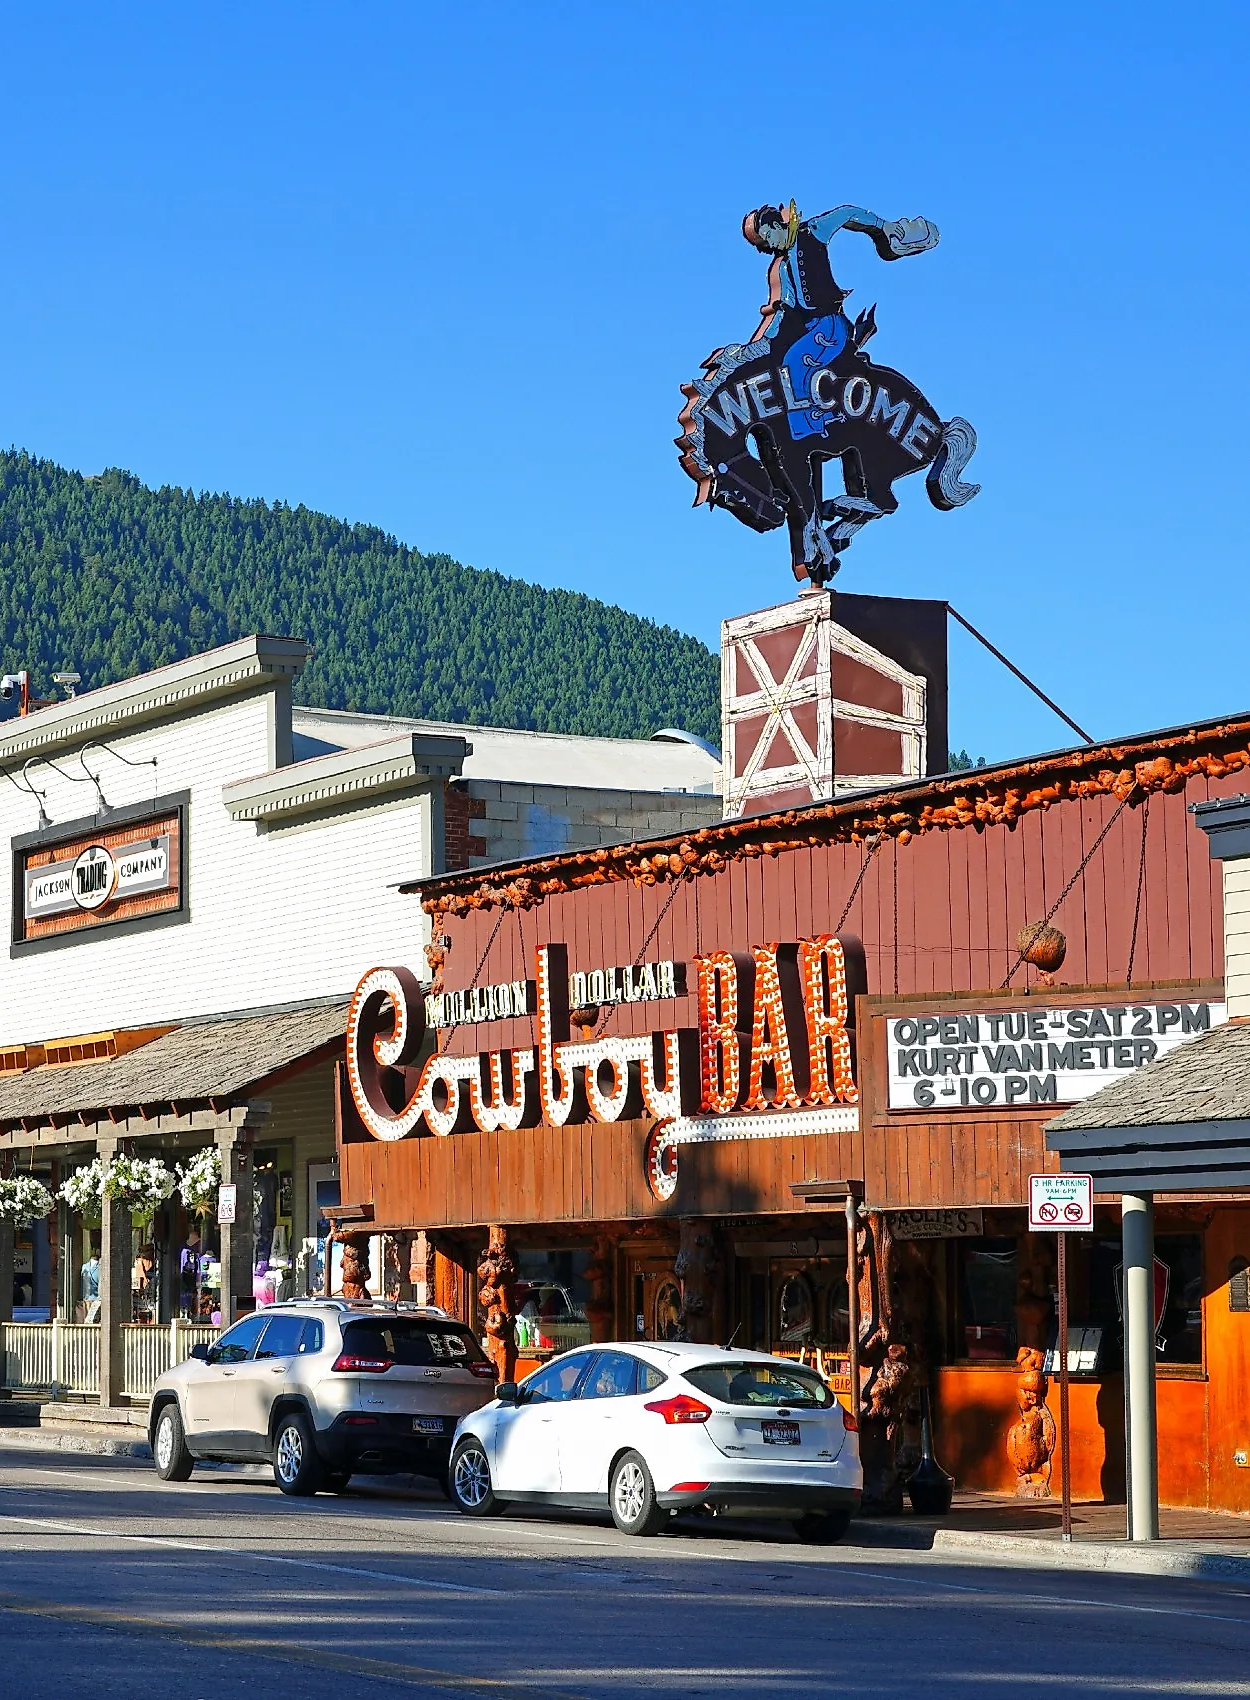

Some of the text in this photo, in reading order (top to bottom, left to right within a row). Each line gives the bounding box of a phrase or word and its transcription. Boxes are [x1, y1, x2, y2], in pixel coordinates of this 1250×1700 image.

[703, 366, 944, 460] WELCOME
[35, 855, 164, 902] JACKSON TRADING COMPANY
[424, 959, 678, 1028] MILLION DOLLAR
[893, 1013, 980, 1047] OPEN
[347, 932, 860, 1201] Cowboy BAR
[897, 1038, 1159, 1077] KURT VAN METER
[1042, 1179, 1052, 1187] HR
[1055, 1179, 1088, 1187] PARKING
